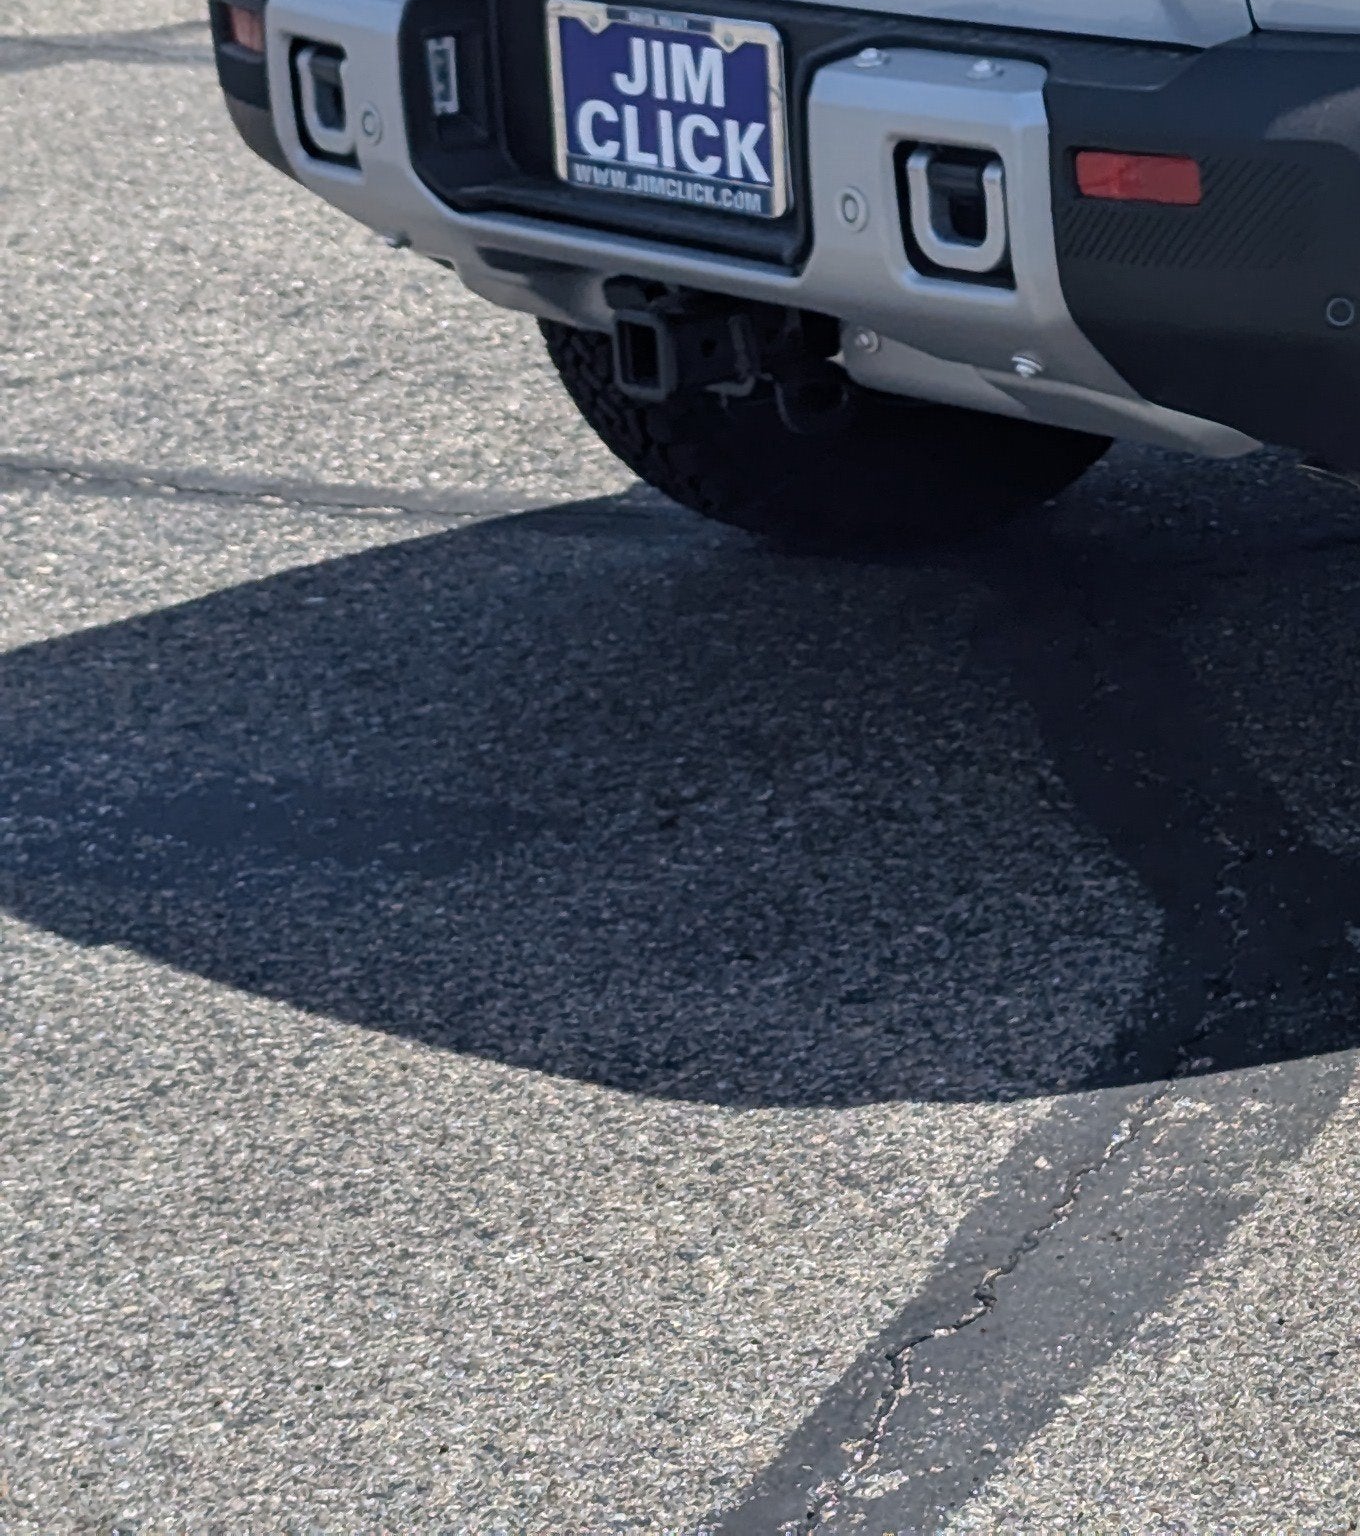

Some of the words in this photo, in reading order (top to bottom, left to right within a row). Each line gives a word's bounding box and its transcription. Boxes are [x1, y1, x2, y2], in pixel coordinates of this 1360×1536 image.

[613, 36, 725, 108] JIM
[577, 99, 771, 184] CLICK
[574, 163, 762, 213] WWW.JIMCLICK.COM
